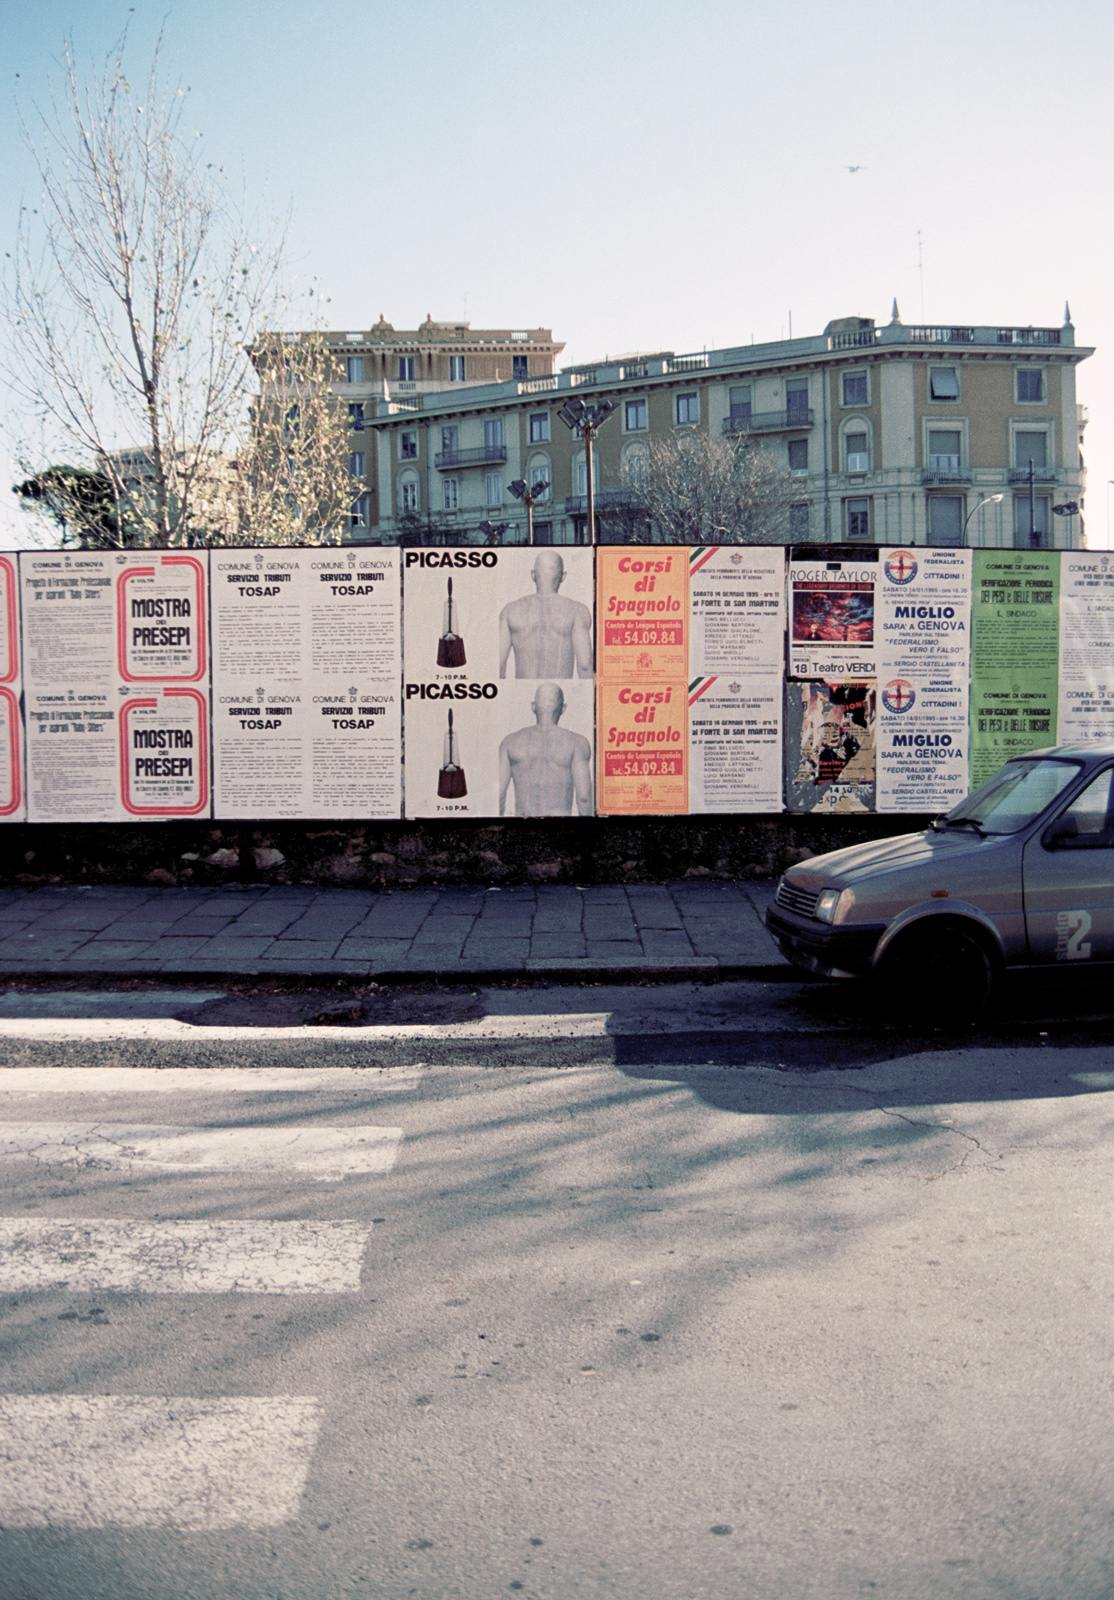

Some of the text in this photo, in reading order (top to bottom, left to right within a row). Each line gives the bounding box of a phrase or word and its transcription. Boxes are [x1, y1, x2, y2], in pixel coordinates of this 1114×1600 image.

[267, 562, 300, 570] GENOVA
[311, 562, 344, 570] COMUNE
[359, 561, 393, 569] GENOVA
[406, 552, 497, 568] PICASSO
[618, 556, 672, 573] Corsi
[227, 574, 291, 582] SERVIZIO TRIBUTI
[320, 573, 384, 581] SERVIZIO TRIBUTI
[790, 570, 878, 582] ROGER TAYLOR
[634, 575, 656, 592] di
[238, 587, 280, 596] TOSAP
[331, 586, 374, 596] TOSAP
[131, 598, 190, 617] MOSTRA
[607, 595, 680, 616] Spagnolo
[894, 606, 954, 618] MIGLIO
[917, 621, 965, 630] GENOVA
[132, 627, 190, 646] PRESEPI
[624, 631, 675, 644] 54.09.84
[795, 664, 808, 673] 18
[812, 662, 875, 673] Teatro VERDI
[406, 683, 498, 699] PICASSO
[618, 687, 672, 704] Corsi
[219, 696, 253, 704] COMUNE
[229, 707, 292, 716] SERVIZIO TRIBUTI
[322, 707, 385, 715] SERVIZIO TRIBUTI
[634, 706, 656, 723] di
[240, 720, 282, 730] TOSAP
[332, 719, 374, 729] TOSAP
[134, 730, 193, 748] MOSTRA
[608, 726, 680, 747] Spagnolo
[892, 735, 952, 746] MIGLIO
[914, 749, 962, 758] GENOVA
[135, 758, 192, 776] PRESEPI
[624, 762, 675, 775] 54.09.84
[1066, 910, 1092, 960] 2
